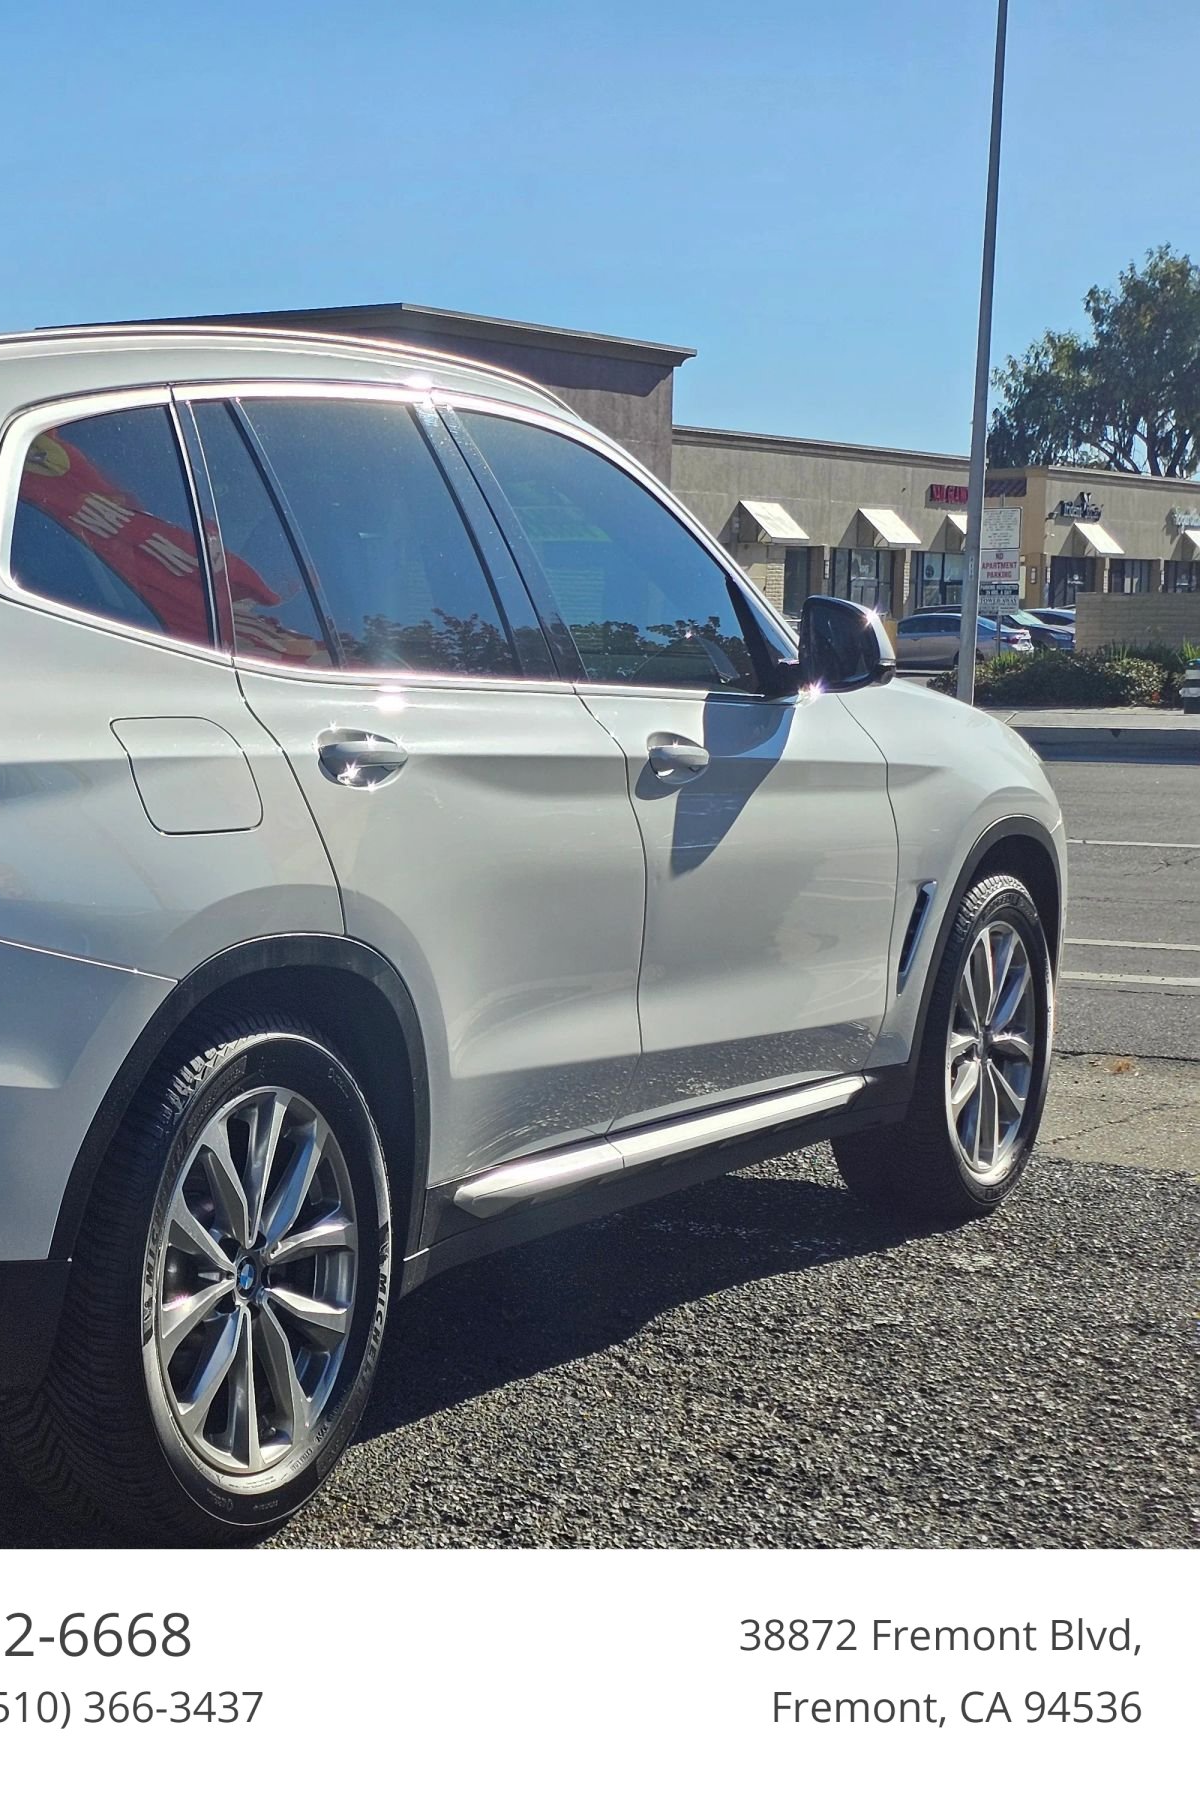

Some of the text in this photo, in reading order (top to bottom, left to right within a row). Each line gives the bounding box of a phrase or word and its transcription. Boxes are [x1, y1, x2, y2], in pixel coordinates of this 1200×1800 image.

[995, 552, 1004, 560] NO
[981, 561, 1018, 570] APARTMENT
[986, 570, 1012, 579] PARKING
